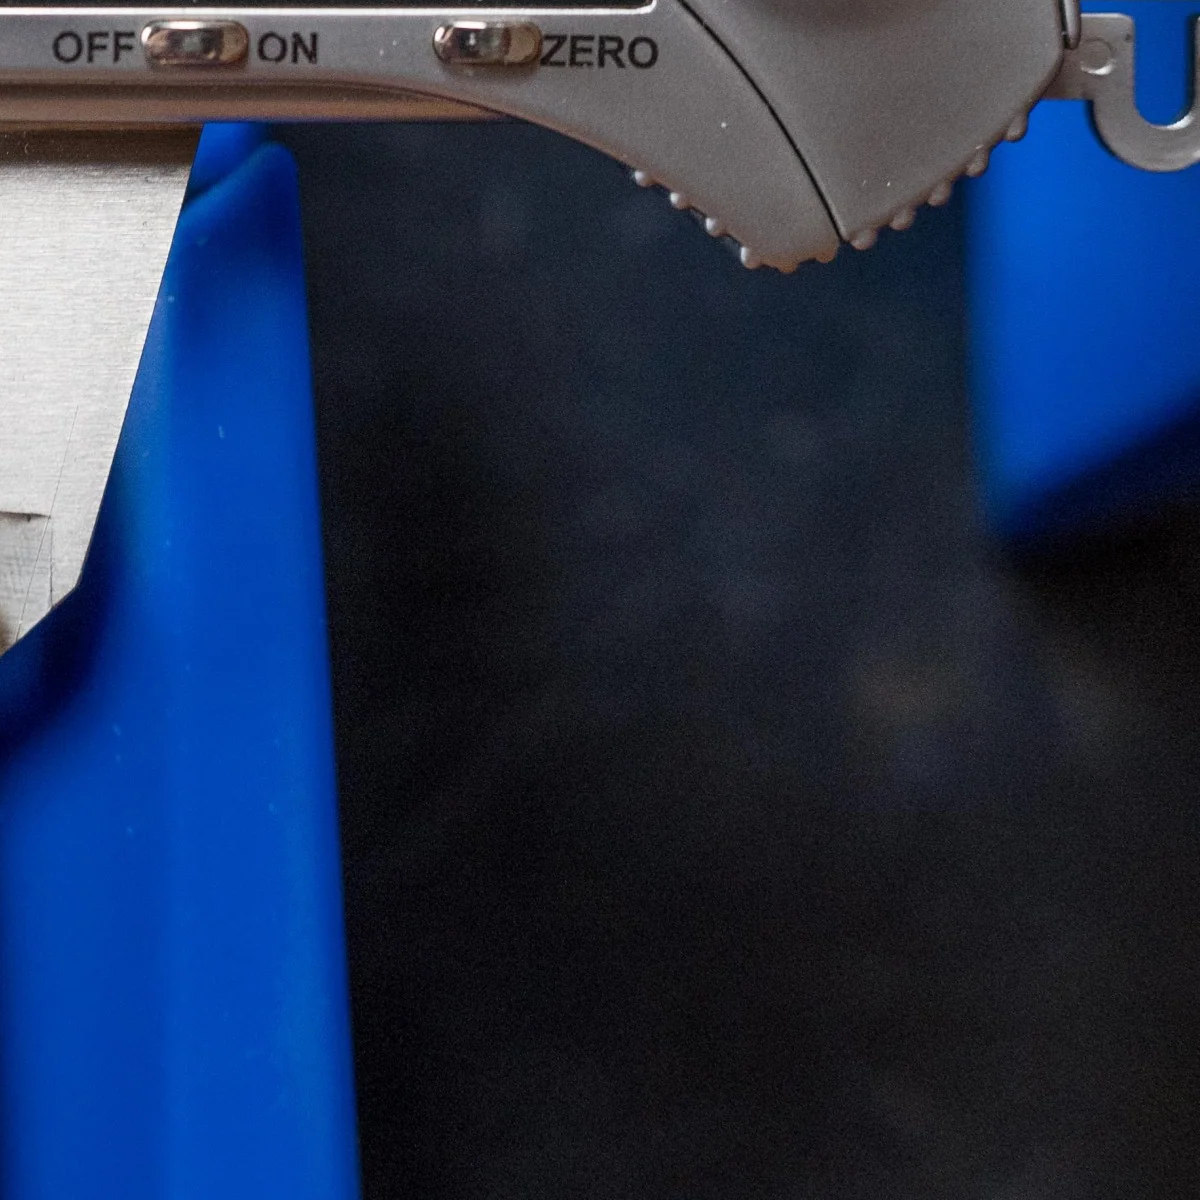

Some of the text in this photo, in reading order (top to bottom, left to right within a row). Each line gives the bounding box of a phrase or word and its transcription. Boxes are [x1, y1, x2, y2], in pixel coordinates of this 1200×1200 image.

[52, 30, 319, 65] OFF ON
[538, 34, 659, 71] ZERO
